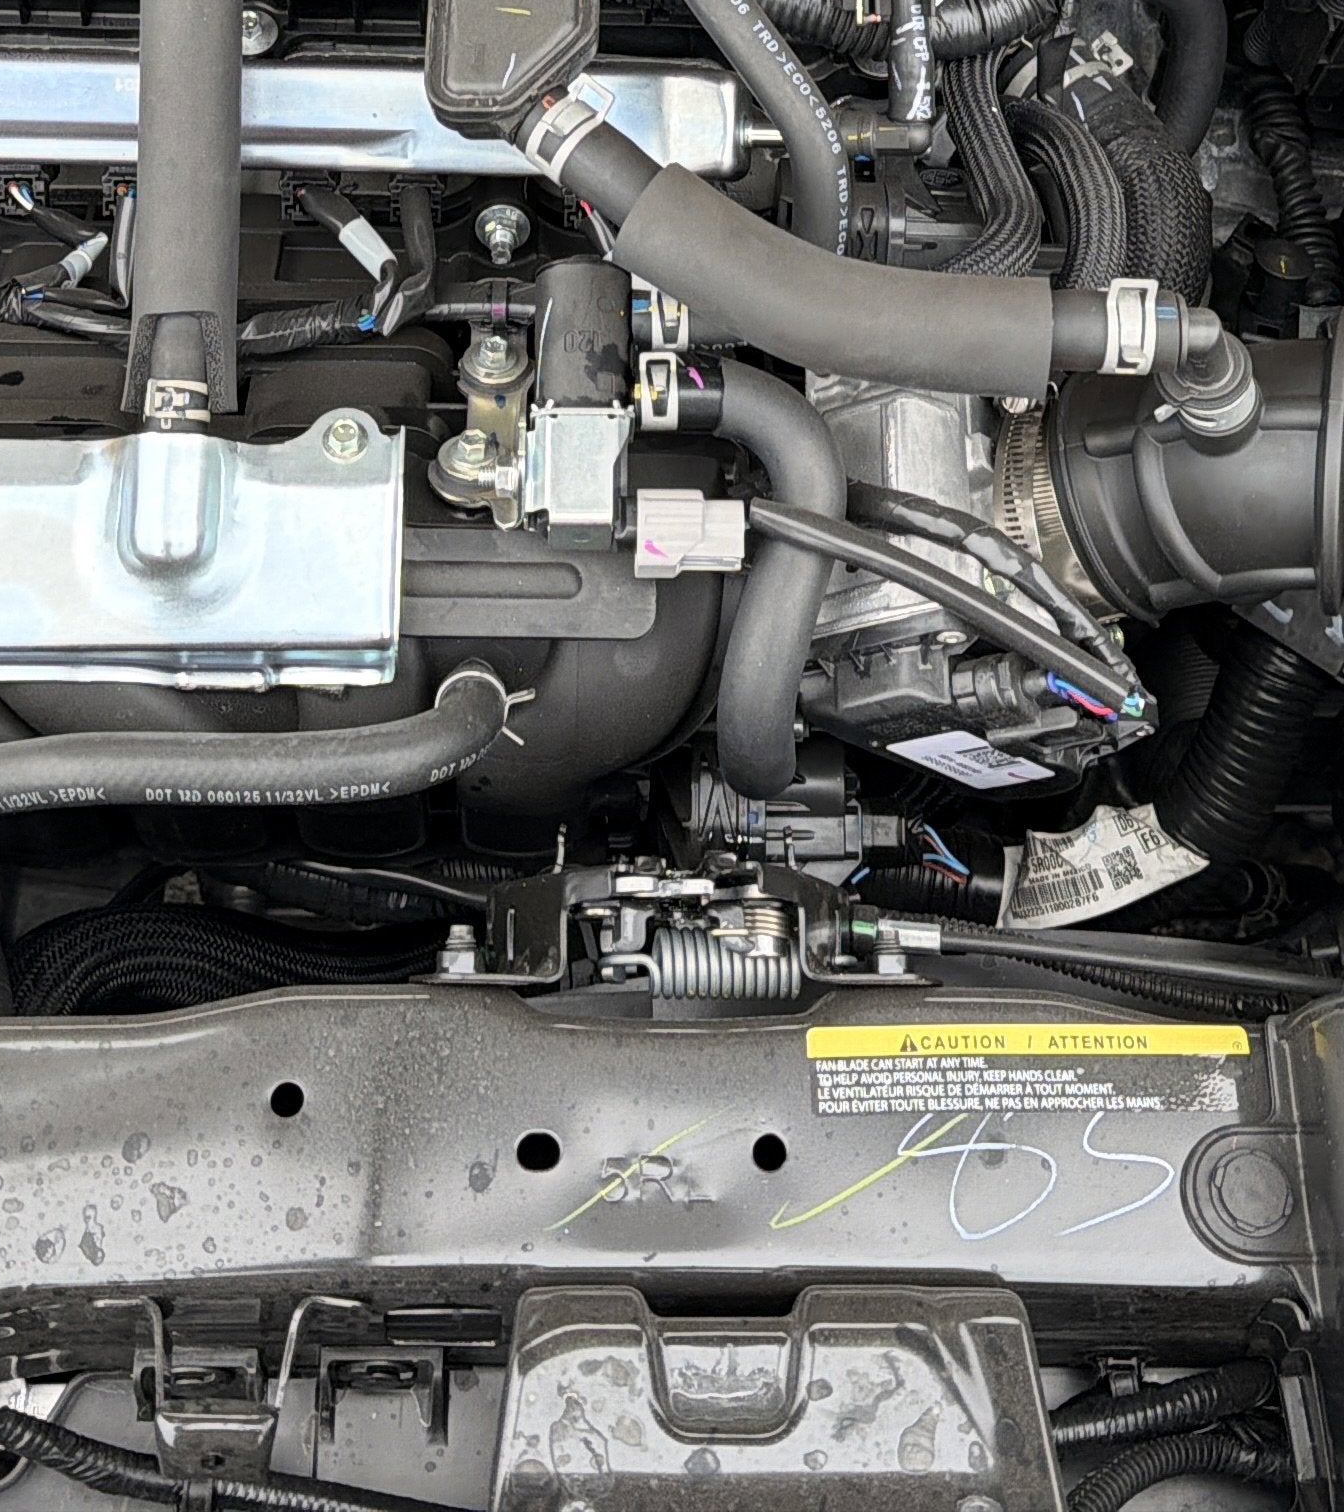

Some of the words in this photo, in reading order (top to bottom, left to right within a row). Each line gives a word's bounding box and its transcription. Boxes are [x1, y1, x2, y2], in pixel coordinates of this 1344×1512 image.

[145, 787, 173, 803] DOT
[207, 788, 262, 804] 060125
[265, 787, 324, 804] 11/32VL
[329, 780, 391, 801] >EPDM<
[430, 761, 458, 783] DOT
[1140, 828, 1162, 850] F6
[1028, 874, 1050, 885] MADE
[1051, 873, 1061, 882] IN
[1062, 863, 1092, 878] MEXICO
[920, 1035, 1006, 1050] CAUTION
[1048, 1035, 1148, 1049] ATTENTION
[871, 1059, 893, 1070] CAN
[894, 1058, 924, 1069] START
[926, 1057, 939, 1068] AT
[940, 1057, 961, 1068] ANY
[818, 1074, 833, 1086] TO
[834, 1073, 858, 1085] HELP
[860, 1072, 892, 1085] AVOID
[894, 1072, 944, 1084] PERSONAL
[946, 1071, 983, 1084] INJURY,
[984, 1070, 1007, 1082] KEEP
[1008, 1070, 1043, 1082] HANDS
[818, 1088, 831, 1100] LE
[906, 1084, 946, 1097] RISQUE
[948, 1084, 963, 1096] DE
[965, 1082, 1024, 1096] DÉMARRER
[1035, 1083, 1063, 1095] TOUT
[1065, 1083, 1117, 1095] MOMENT.
[819, 1101, 850, 1114] POUR
[852, 1099, 888, 1113] ÉVITER
[889, 1099, 925, 1112] TOUTE
[928, 1097, 983, 1111] BLESSURE,
[985, 1097, 1002, 1109] NE
[1002, 1097, 1022, 1109] PAS
[1024, 1097, 1038, 1109] EN
[1041, 1096, 1104, 1109] APPROCHER
[1105, 1095, 1124, 1109] LES
